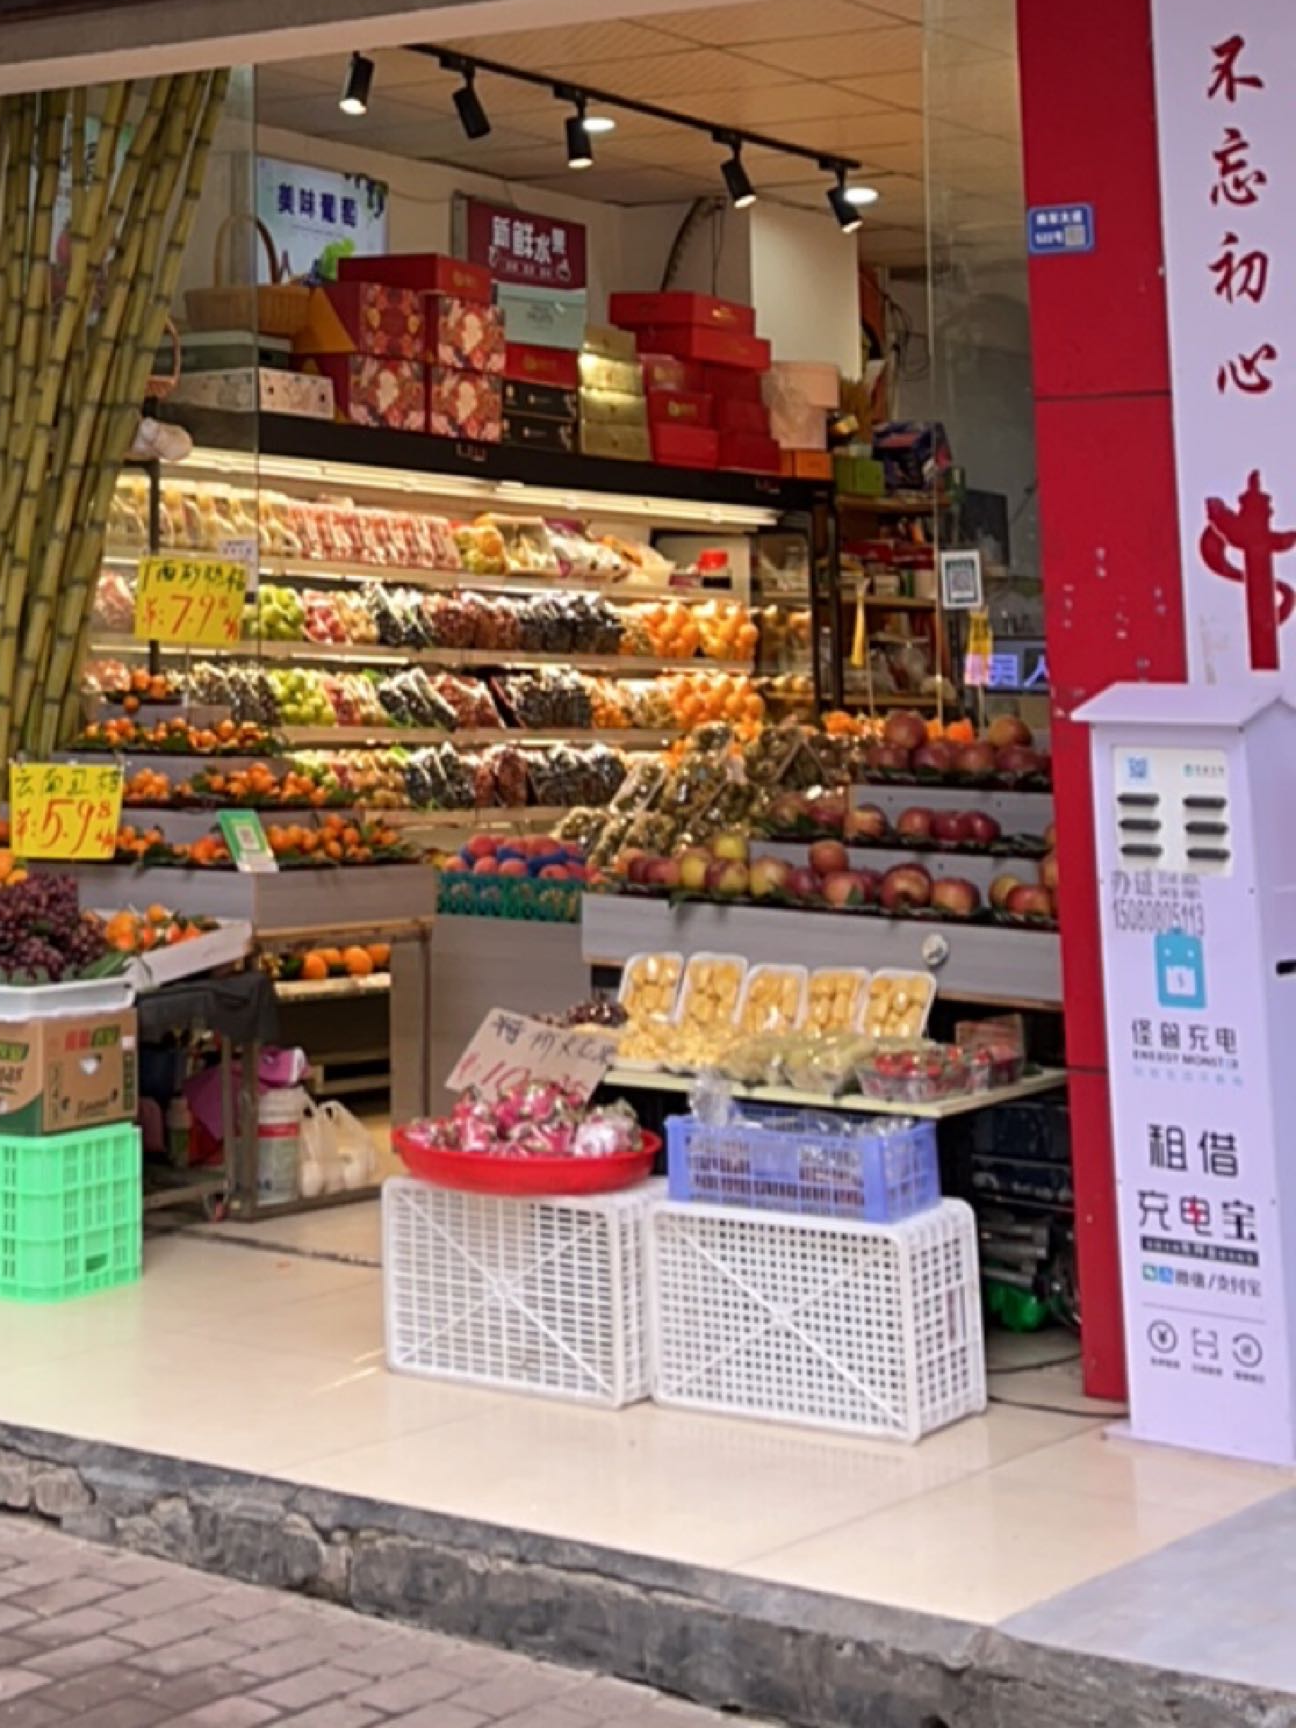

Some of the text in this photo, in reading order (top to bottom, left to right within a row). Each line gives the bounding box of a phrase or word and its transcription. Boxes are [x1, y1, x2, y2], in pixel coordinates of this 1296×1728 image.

[1207, 34, 1278, 395] 不忘初心
[1131, 1018, 1238, 1055] 怪兽充电
[1147, 1124, 1239, 1179] 租借
[1137, 1188, 1259, 1242] 充电宝
